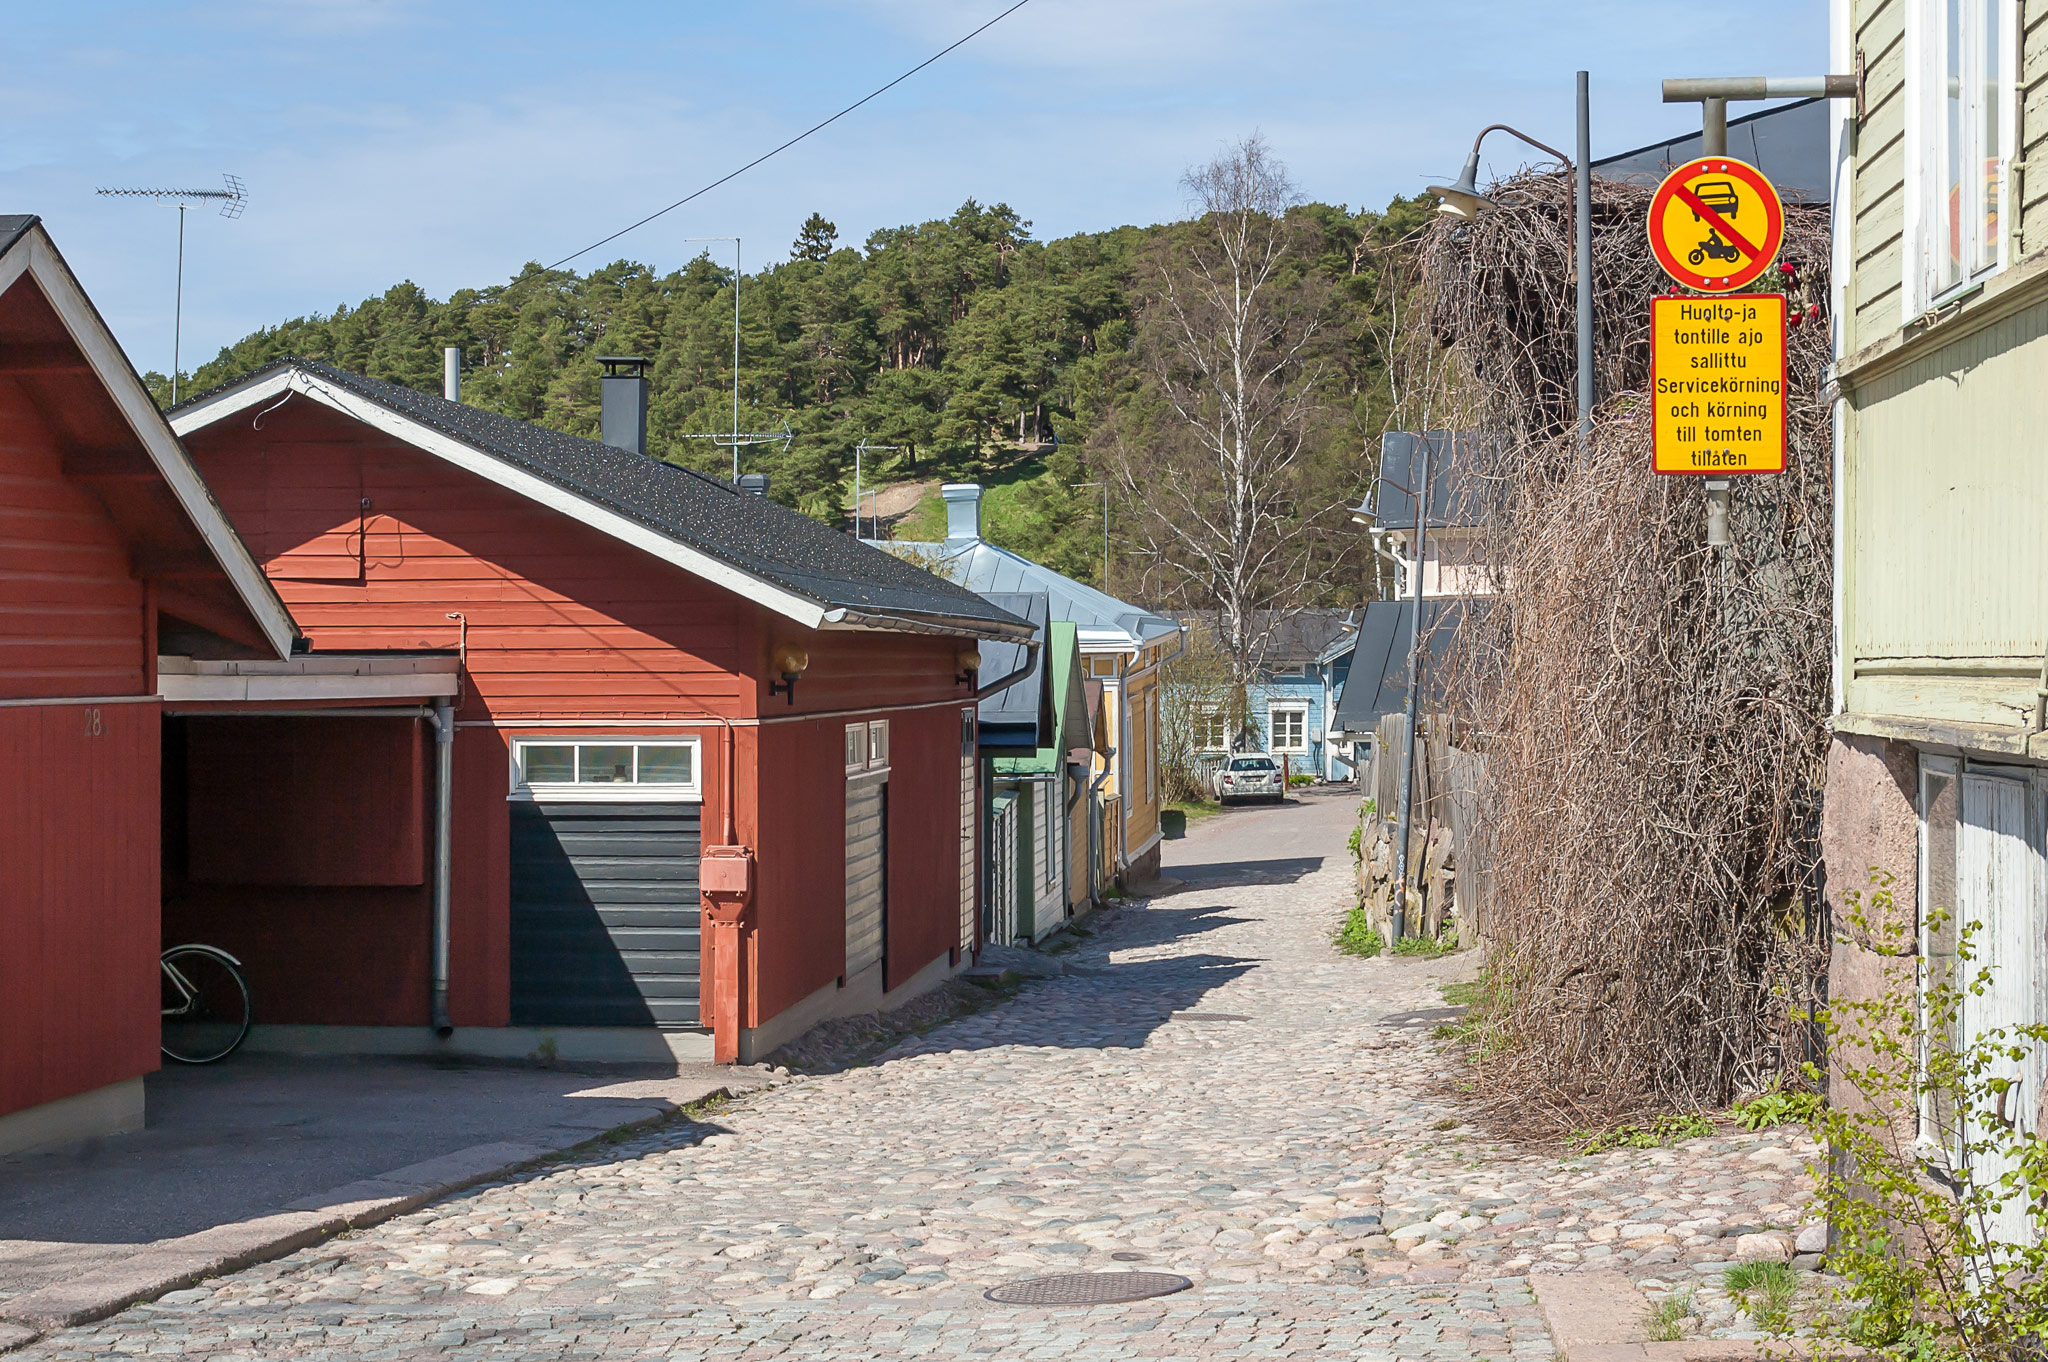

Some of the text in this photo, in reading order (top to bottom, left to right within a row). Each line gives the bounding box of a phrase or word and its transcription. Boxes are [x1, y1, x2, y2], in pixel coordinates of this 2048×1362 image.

[1674, 328, 1763, 347] tontille ajo
[1690, 353, 1747, 369] sallittu
[1657, 377, 1780, 395] Servicekörning
[1671, 402, 1767, 420] och körning
[1676, 426, 1762, 442] till tomten
[1691, 450, 1747, 467] tillåten
[84, 708, 101, 737] 28
